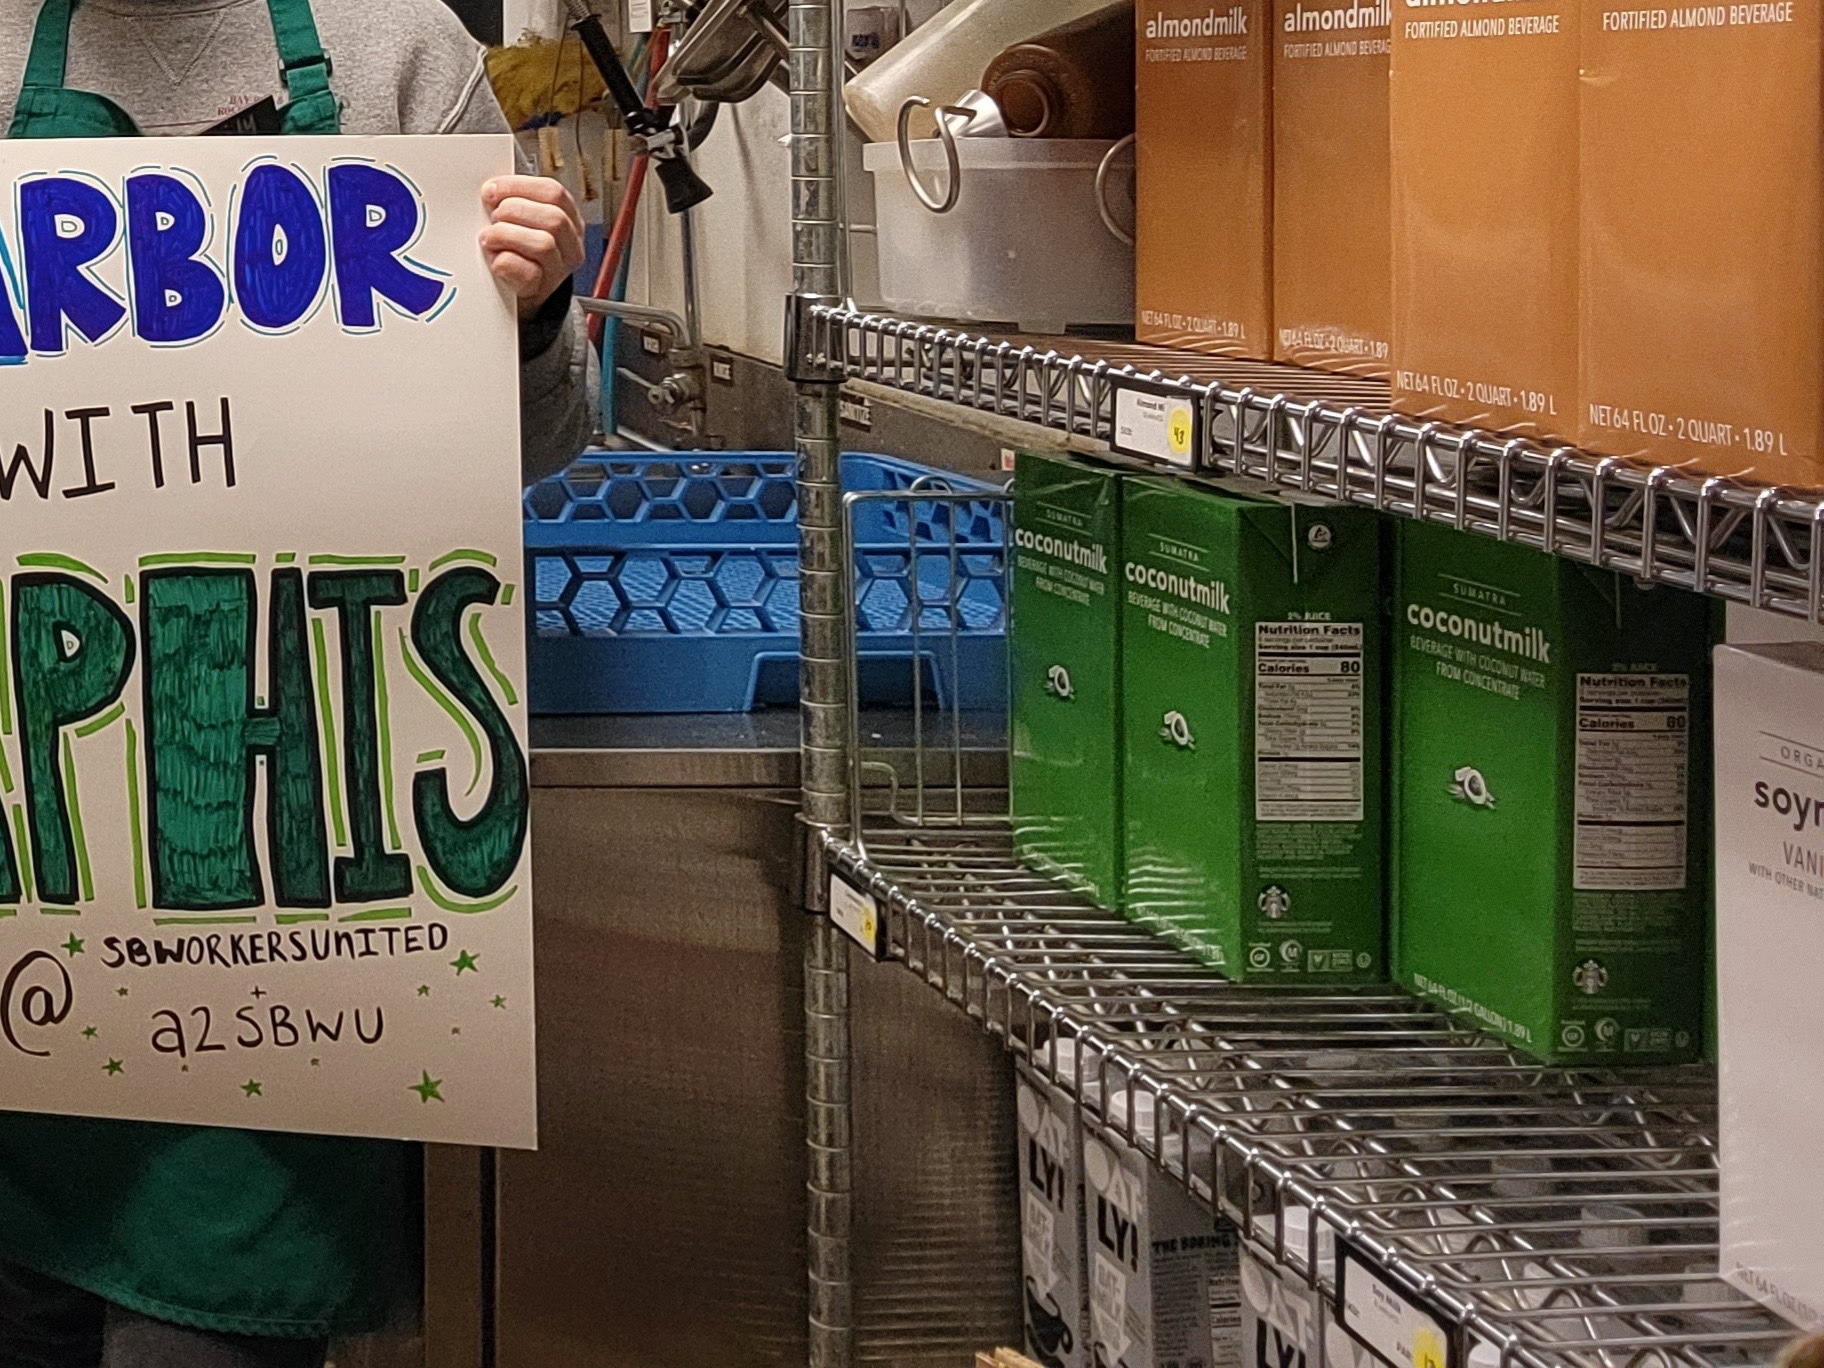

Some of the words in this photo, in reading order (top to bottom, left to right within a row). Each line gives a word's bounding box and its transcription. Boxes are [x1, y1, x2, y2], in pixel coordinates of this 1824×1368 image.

[1145, 7, 1248, 39] almondmilk
[1404, 18, 1458, 40] FORTIFIED
[1460, 16, 1506, 37] ALMOND
[1508, 14, 1560, 36] BEVERAGE
[1602, 8, 1667, 31] FORTIFIED
[1670, 5, 1726, 28] ALMOND
[1729, 1, 1794, 25] BEVERAGE
[1283, 42, 1322, 59] FORTIFIED
[1324, 40, 1358, 57] ALMOND
[1397, 369, 1414, 392] NET
[1414, 372, 1429, 393] 64
[1430, 374, 1443, 396] FL
[1443, 377, 1460, 399] OZ
[1476, 382, 1512, 407] QUART
[1519, 389, 1545, 413] 1.89
[1589, 403, 1610, 428] NET
[1611, 406, 1630, 430] 64
[1632, 410, 1647, 433] FL
[1648, 413, 1668, 437] OZ
[1687, 419, 1732, 447] QUART
[1742, 428, 1775, 453] 1.89
[1015, 528, 1108, 574] coconutmilk
[1159, 541, 1199, 562] SUMATRA
[1125, 561, 1231, 615] coconutmilk
[1128, 590, 1162, 613] BEVERAGE
[1452, 582, 1507, 607] SUMATRA
[1258, 624, 1320, 635] Nutrition
[1323, 625, 1361, 636] Facts
[1406, 602, 1550, 665] coconutmilk
[1257, 662, 1310, 673] Calories
[1340, 660, 1361, 673] 80
[1410, 634, 1455, 662] BEVERAGE
[1455, 646, 1477, 667] WITH
[1478, 653, 1519, 681] COCONUT
[1519, 666, 1546, 689] WATER
[1436, 662, 1462, 684] FROM
[1462, 670, 1520, 701] CONCENTRATE
[1579, 675, 1646, 688] Nutrition
[1578, 717, 1636, 729] Calories
[1749, 861, 1773, 881] WITH
[1774, 871, 1805, 893] OTHER
[0, 950, 74, 1056] @
[100, 923, 449, 969] SBWORKERSUNITED
[1030, 1138, 1064, 1213] LY!
[1098, 1192, 1138, 1273] LY!
